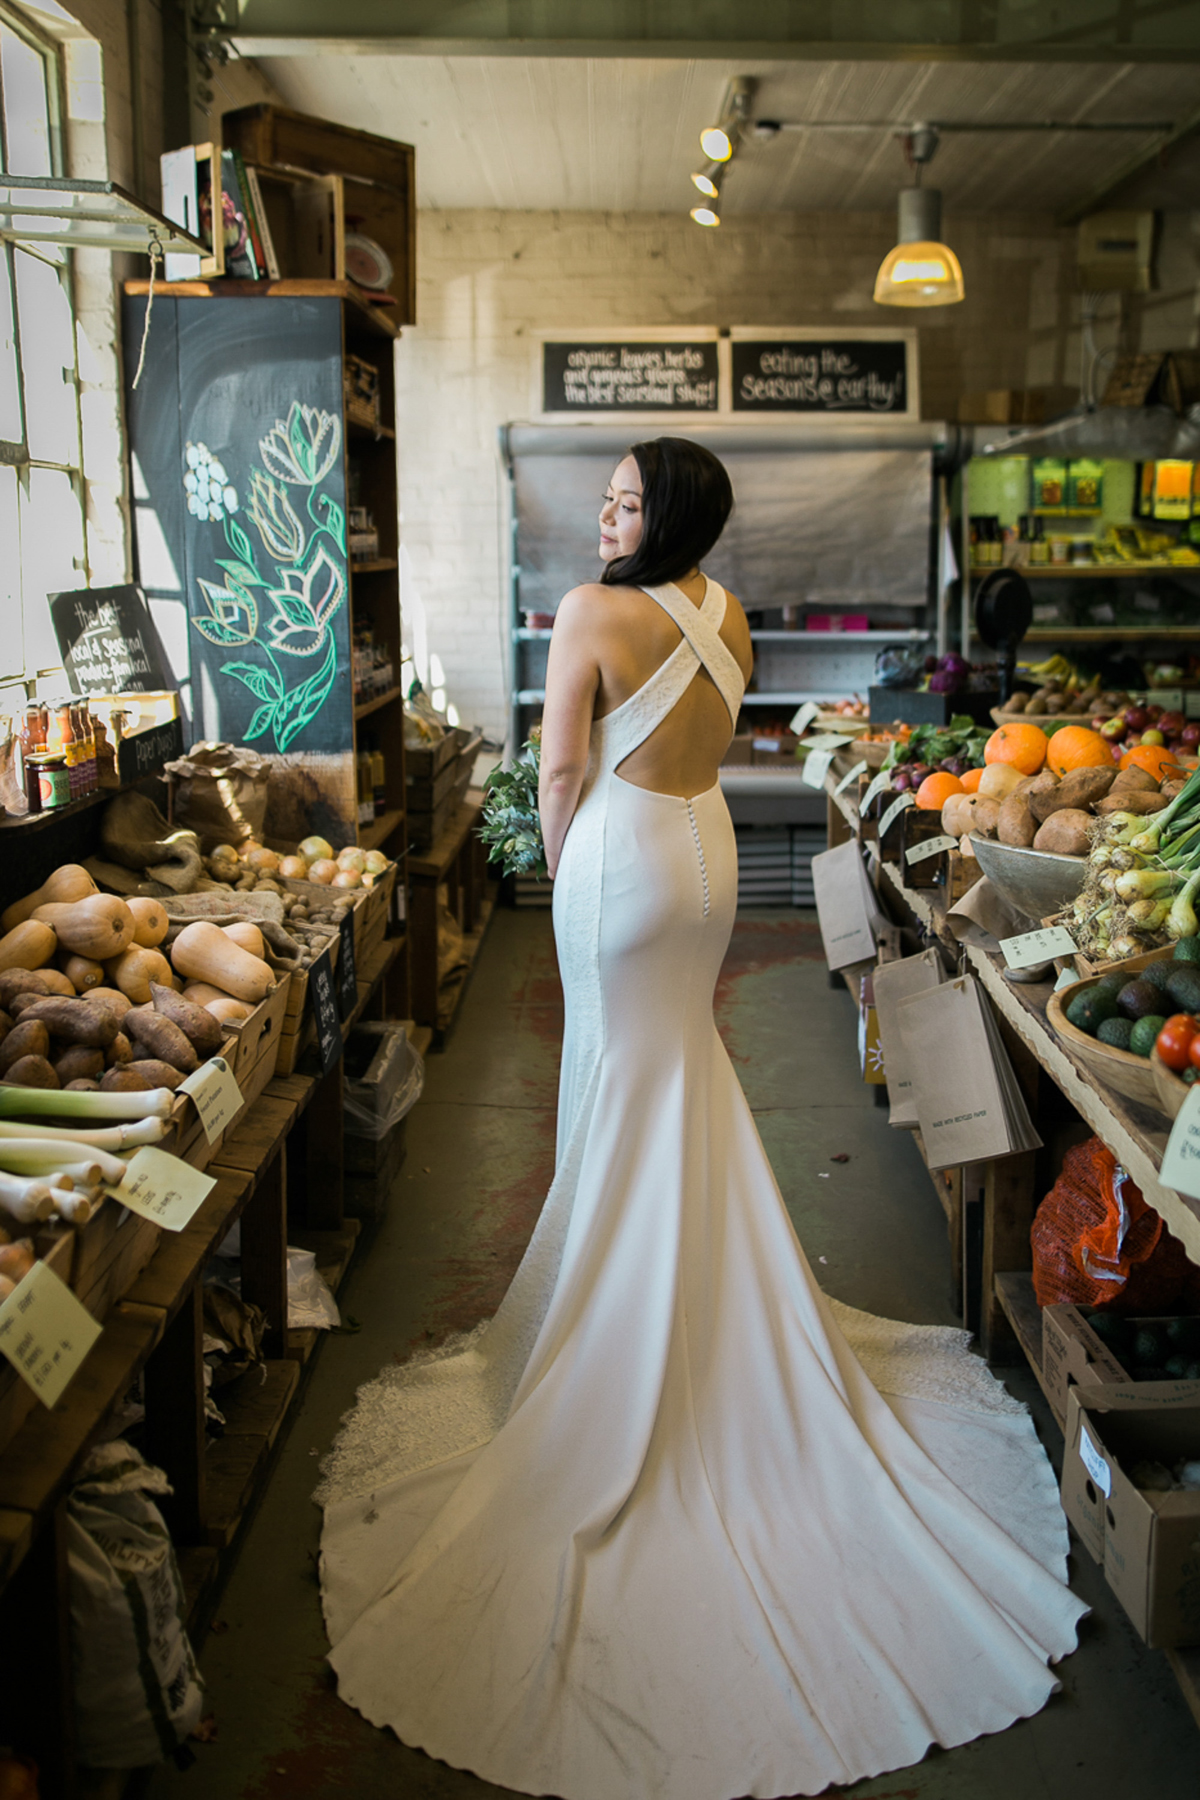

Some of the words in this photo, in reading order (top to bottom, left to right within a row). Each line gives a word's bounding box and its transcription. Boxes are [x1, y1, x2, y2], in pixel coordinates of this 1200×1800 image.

[568, 348, 617, 370] organic
[665, 347, 704, 369] herbs
[760, 346, 819, 381] eating
[821, 347, 860, 375] the
[563, 366, 588, 384] and
[589, 367, 643, 387] gorgeous
[565, 383, 587, 403] the
[587, 383, 614, 404] best
[819, 376, 835, 401] @
[74, 601, 99, 630] the
[95, 599, 121, 627] best
[67, 637, 94, 664] local
[129, 653, 152, 675] local
[932, 1120, 944, 1129] MADE
[944, 1117, 954, 1126] WITH
[954, 1112, 974, 1123] RECYCLED
[973, 1109, 988, 1119] PAPER
